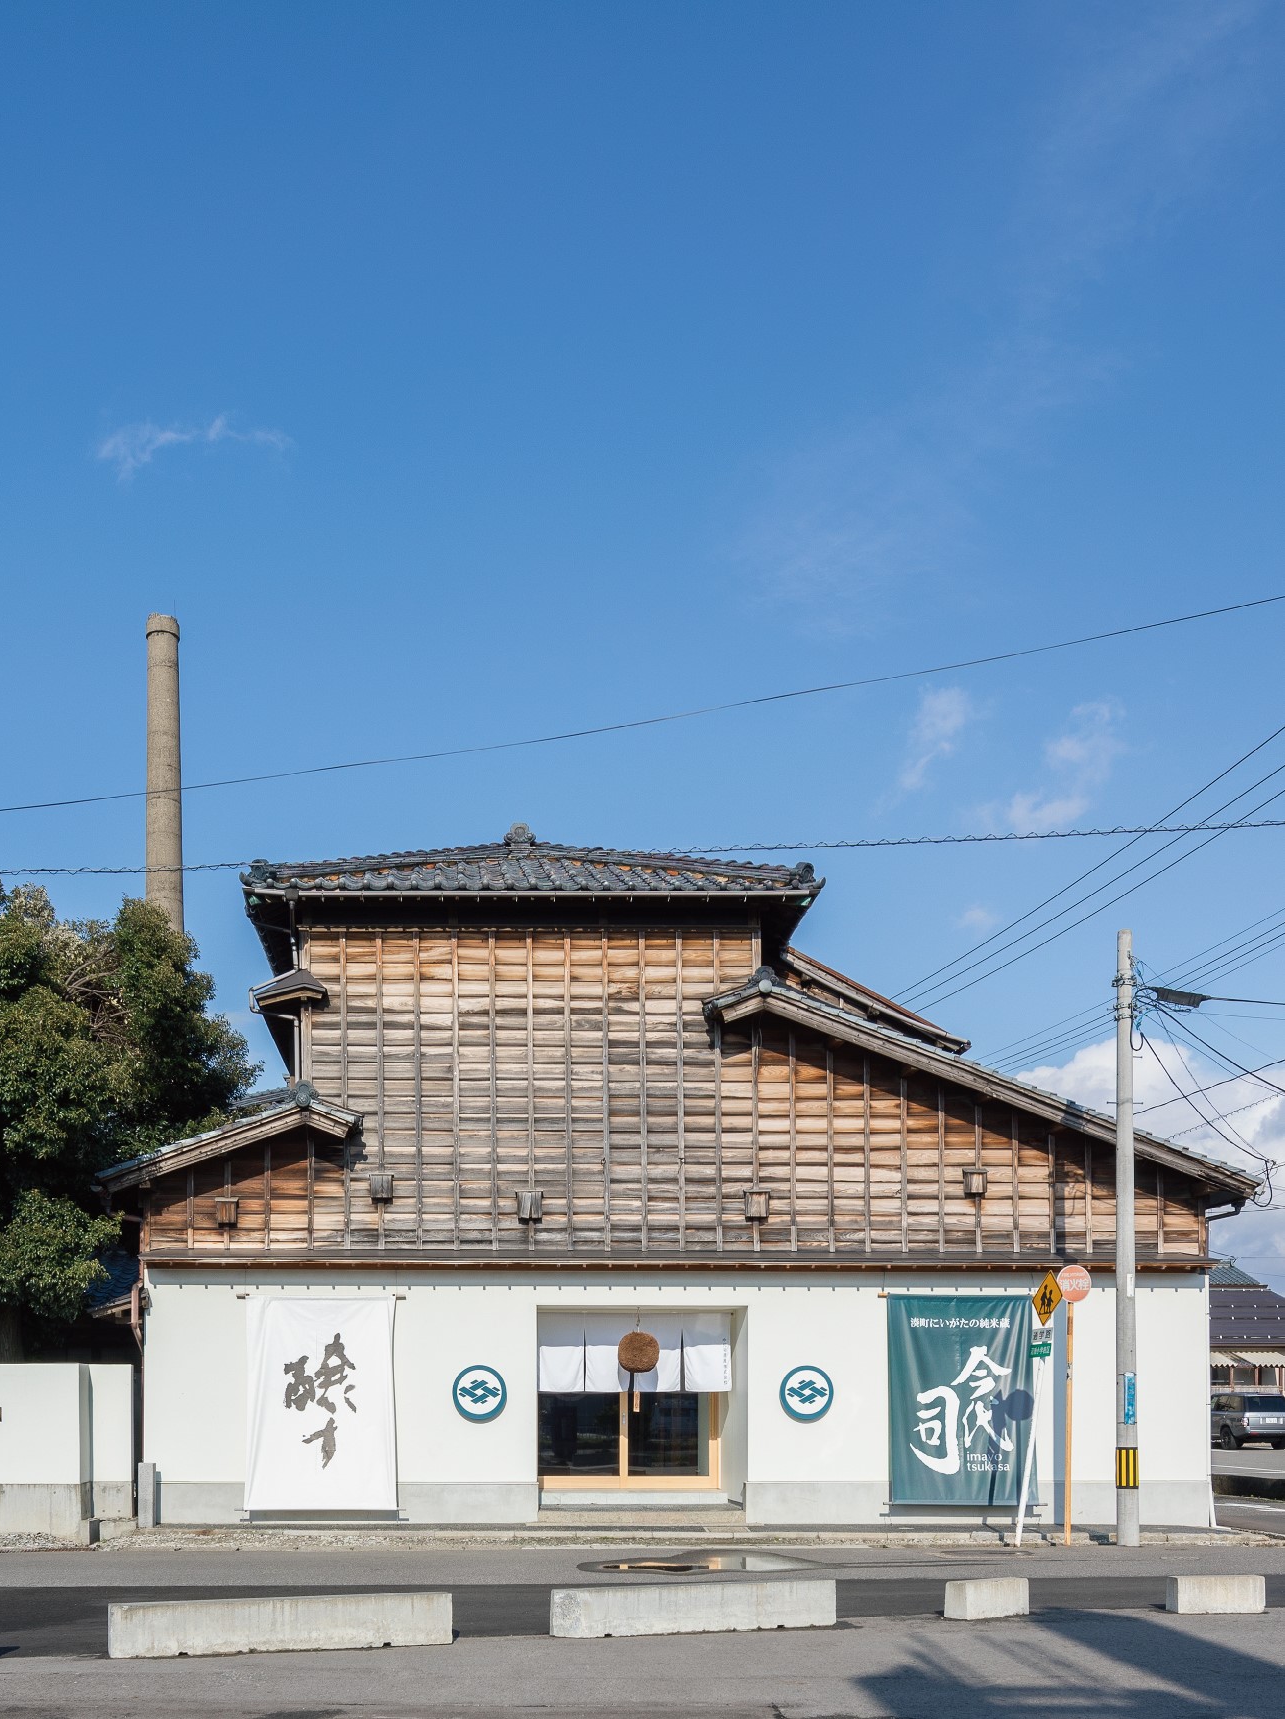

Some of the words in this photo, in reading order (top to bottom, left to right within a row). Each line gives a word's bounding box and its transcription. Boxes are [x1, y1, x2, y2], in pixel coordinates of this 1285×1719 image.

[1059, 1278, 1090, 1292] 消火栓
[910, 1317, 1011, 1329] 湊町にいがたの純米蔵
[966, 1451, 1003, 1463] imayo
[966, 1461, 1011, 1472] tsukasa
